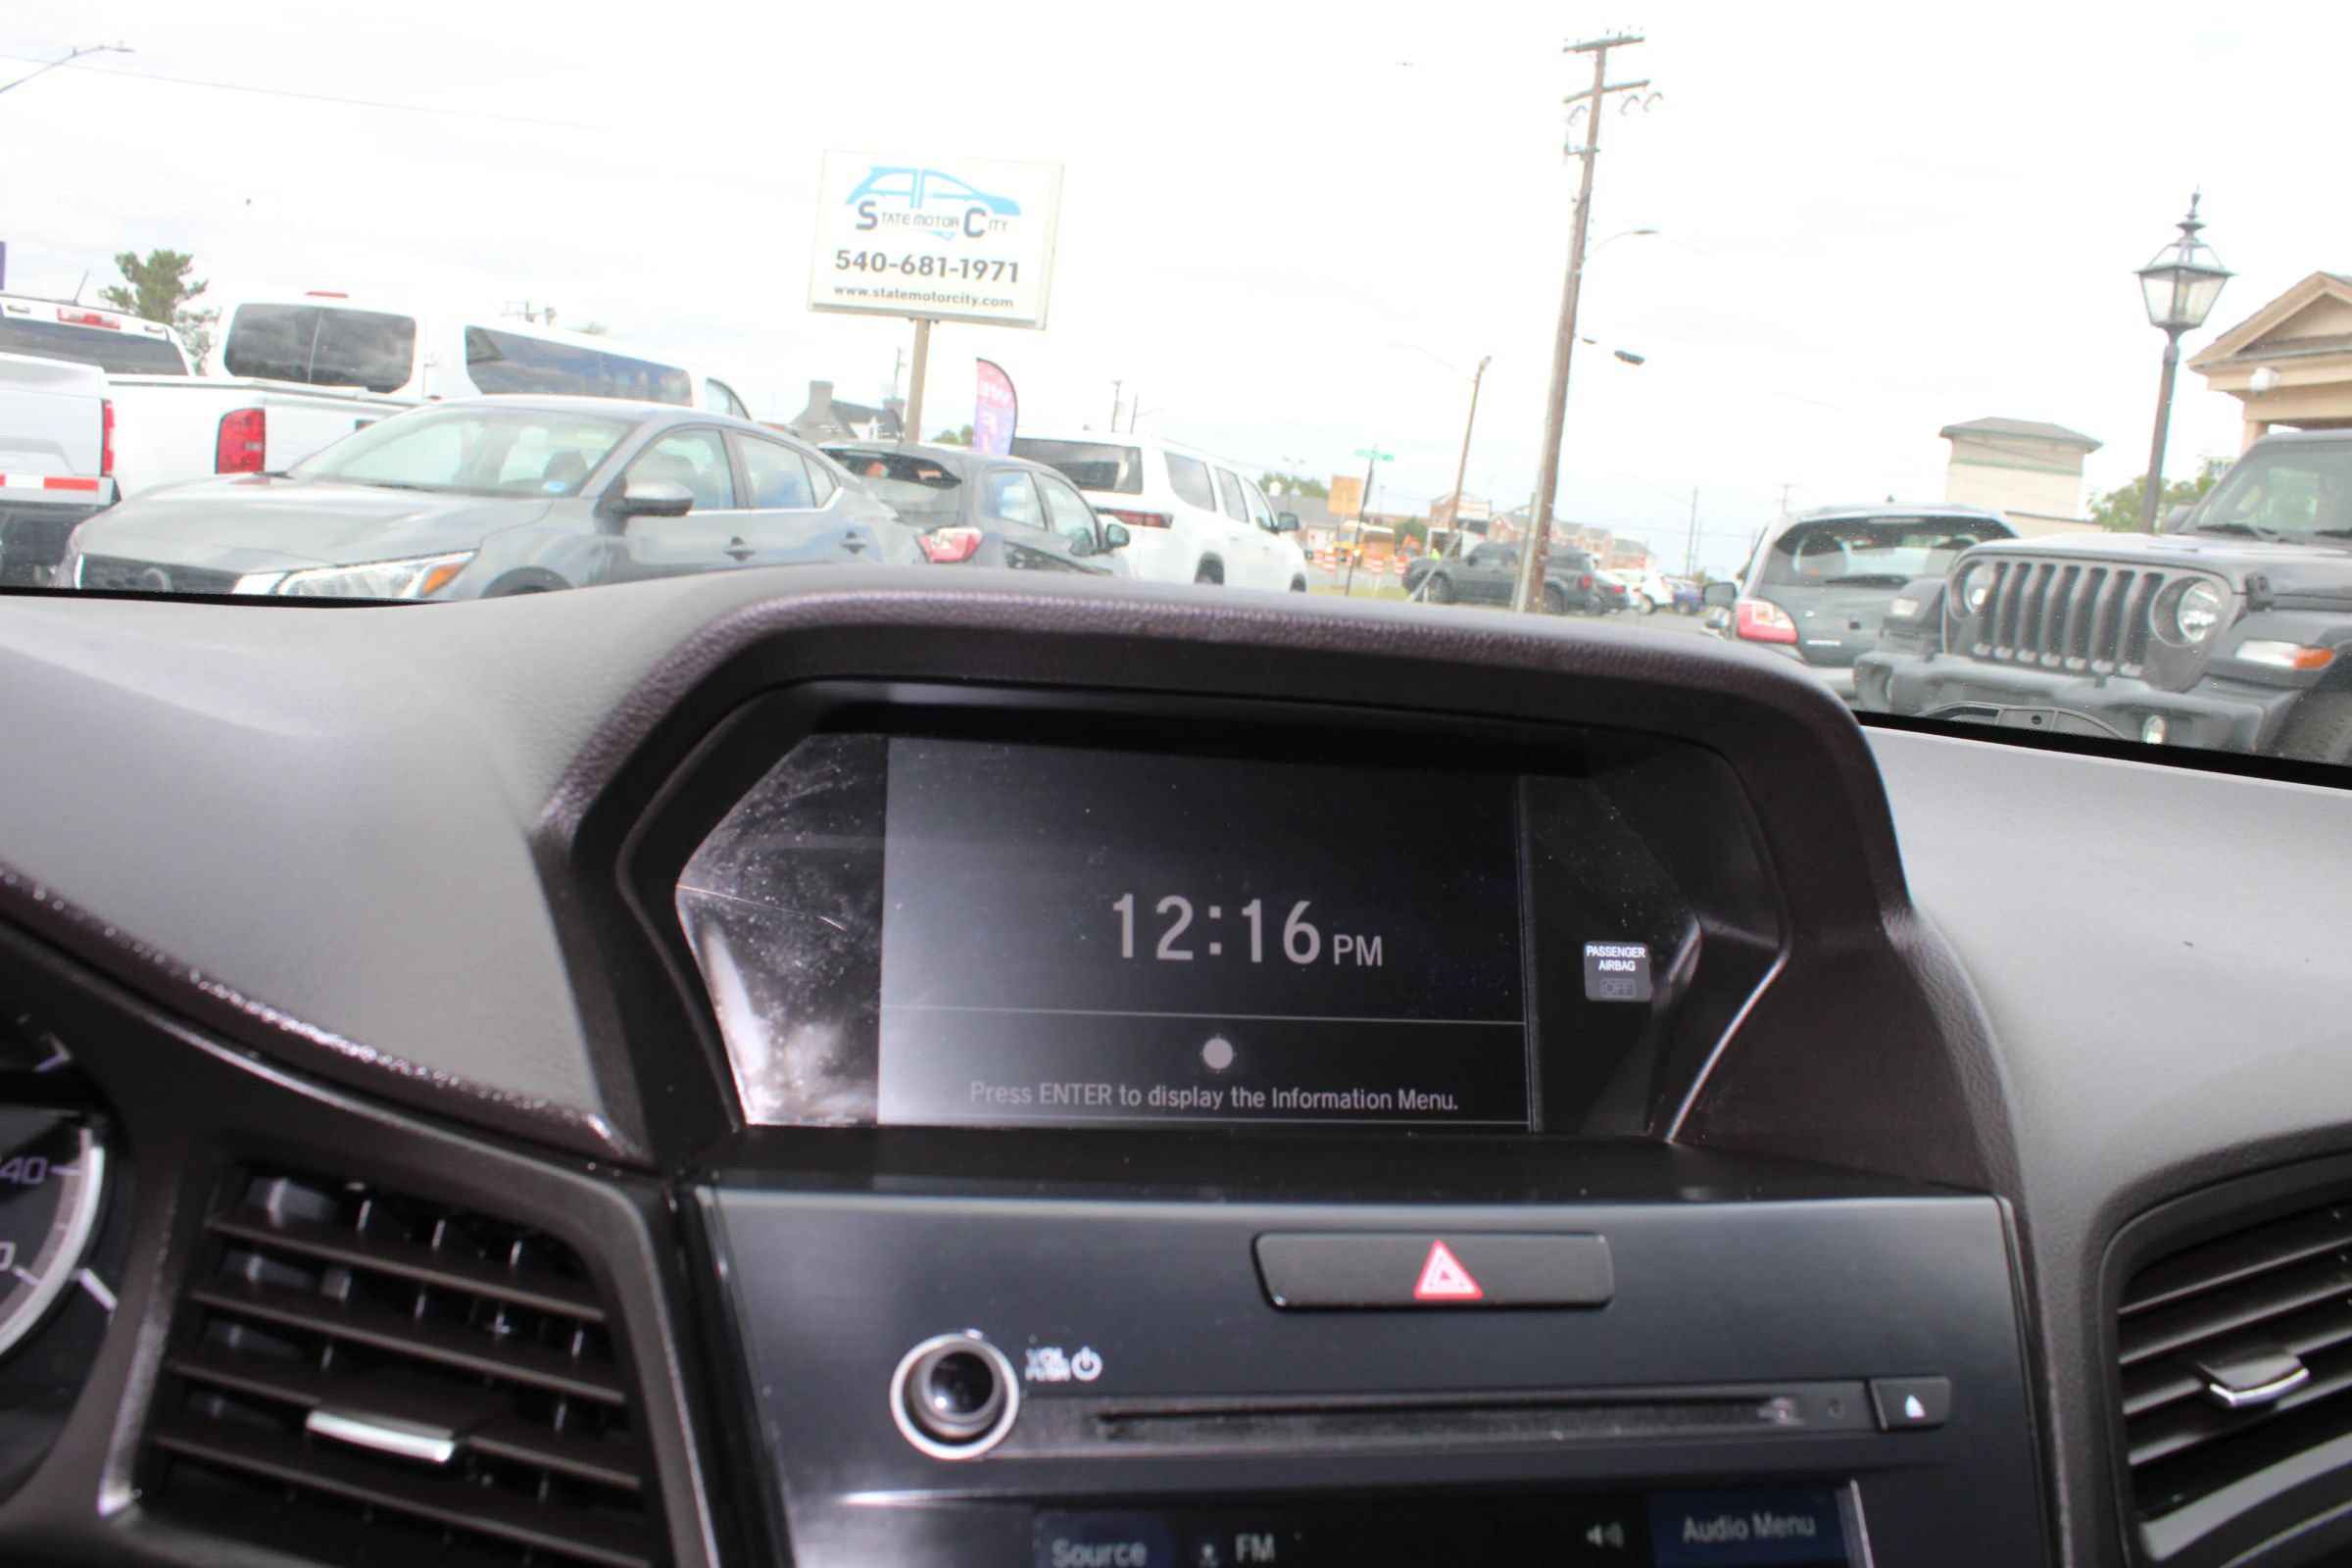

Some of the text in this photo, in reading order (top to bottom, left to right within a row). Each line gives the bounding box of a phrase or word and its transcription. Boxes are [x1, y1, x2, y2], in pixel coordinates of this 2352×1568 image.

[856, 200, 1008, 238] STATE MOTOR CITY
[835, 249, 1020, 282] 540-681-1971
[833, 283, 1014, 309] www.statemotorcity.com
[1113, 893, 1383, 966] 12:16 PM
[1586, 945, 1646, 958] PASSENGER
[1598, 959, 1636, 972] AIRBAG
[1603, 982, 1632, 995] OFF
[970, 1081, 1459, 1110] Press ENTER to display the Information Menu.
[1683, 1512, 1816, 1543] Audio Menu
[1052, 1537, 1148, 1568] Source
[1235, 1533, 1275, 1563] FM
